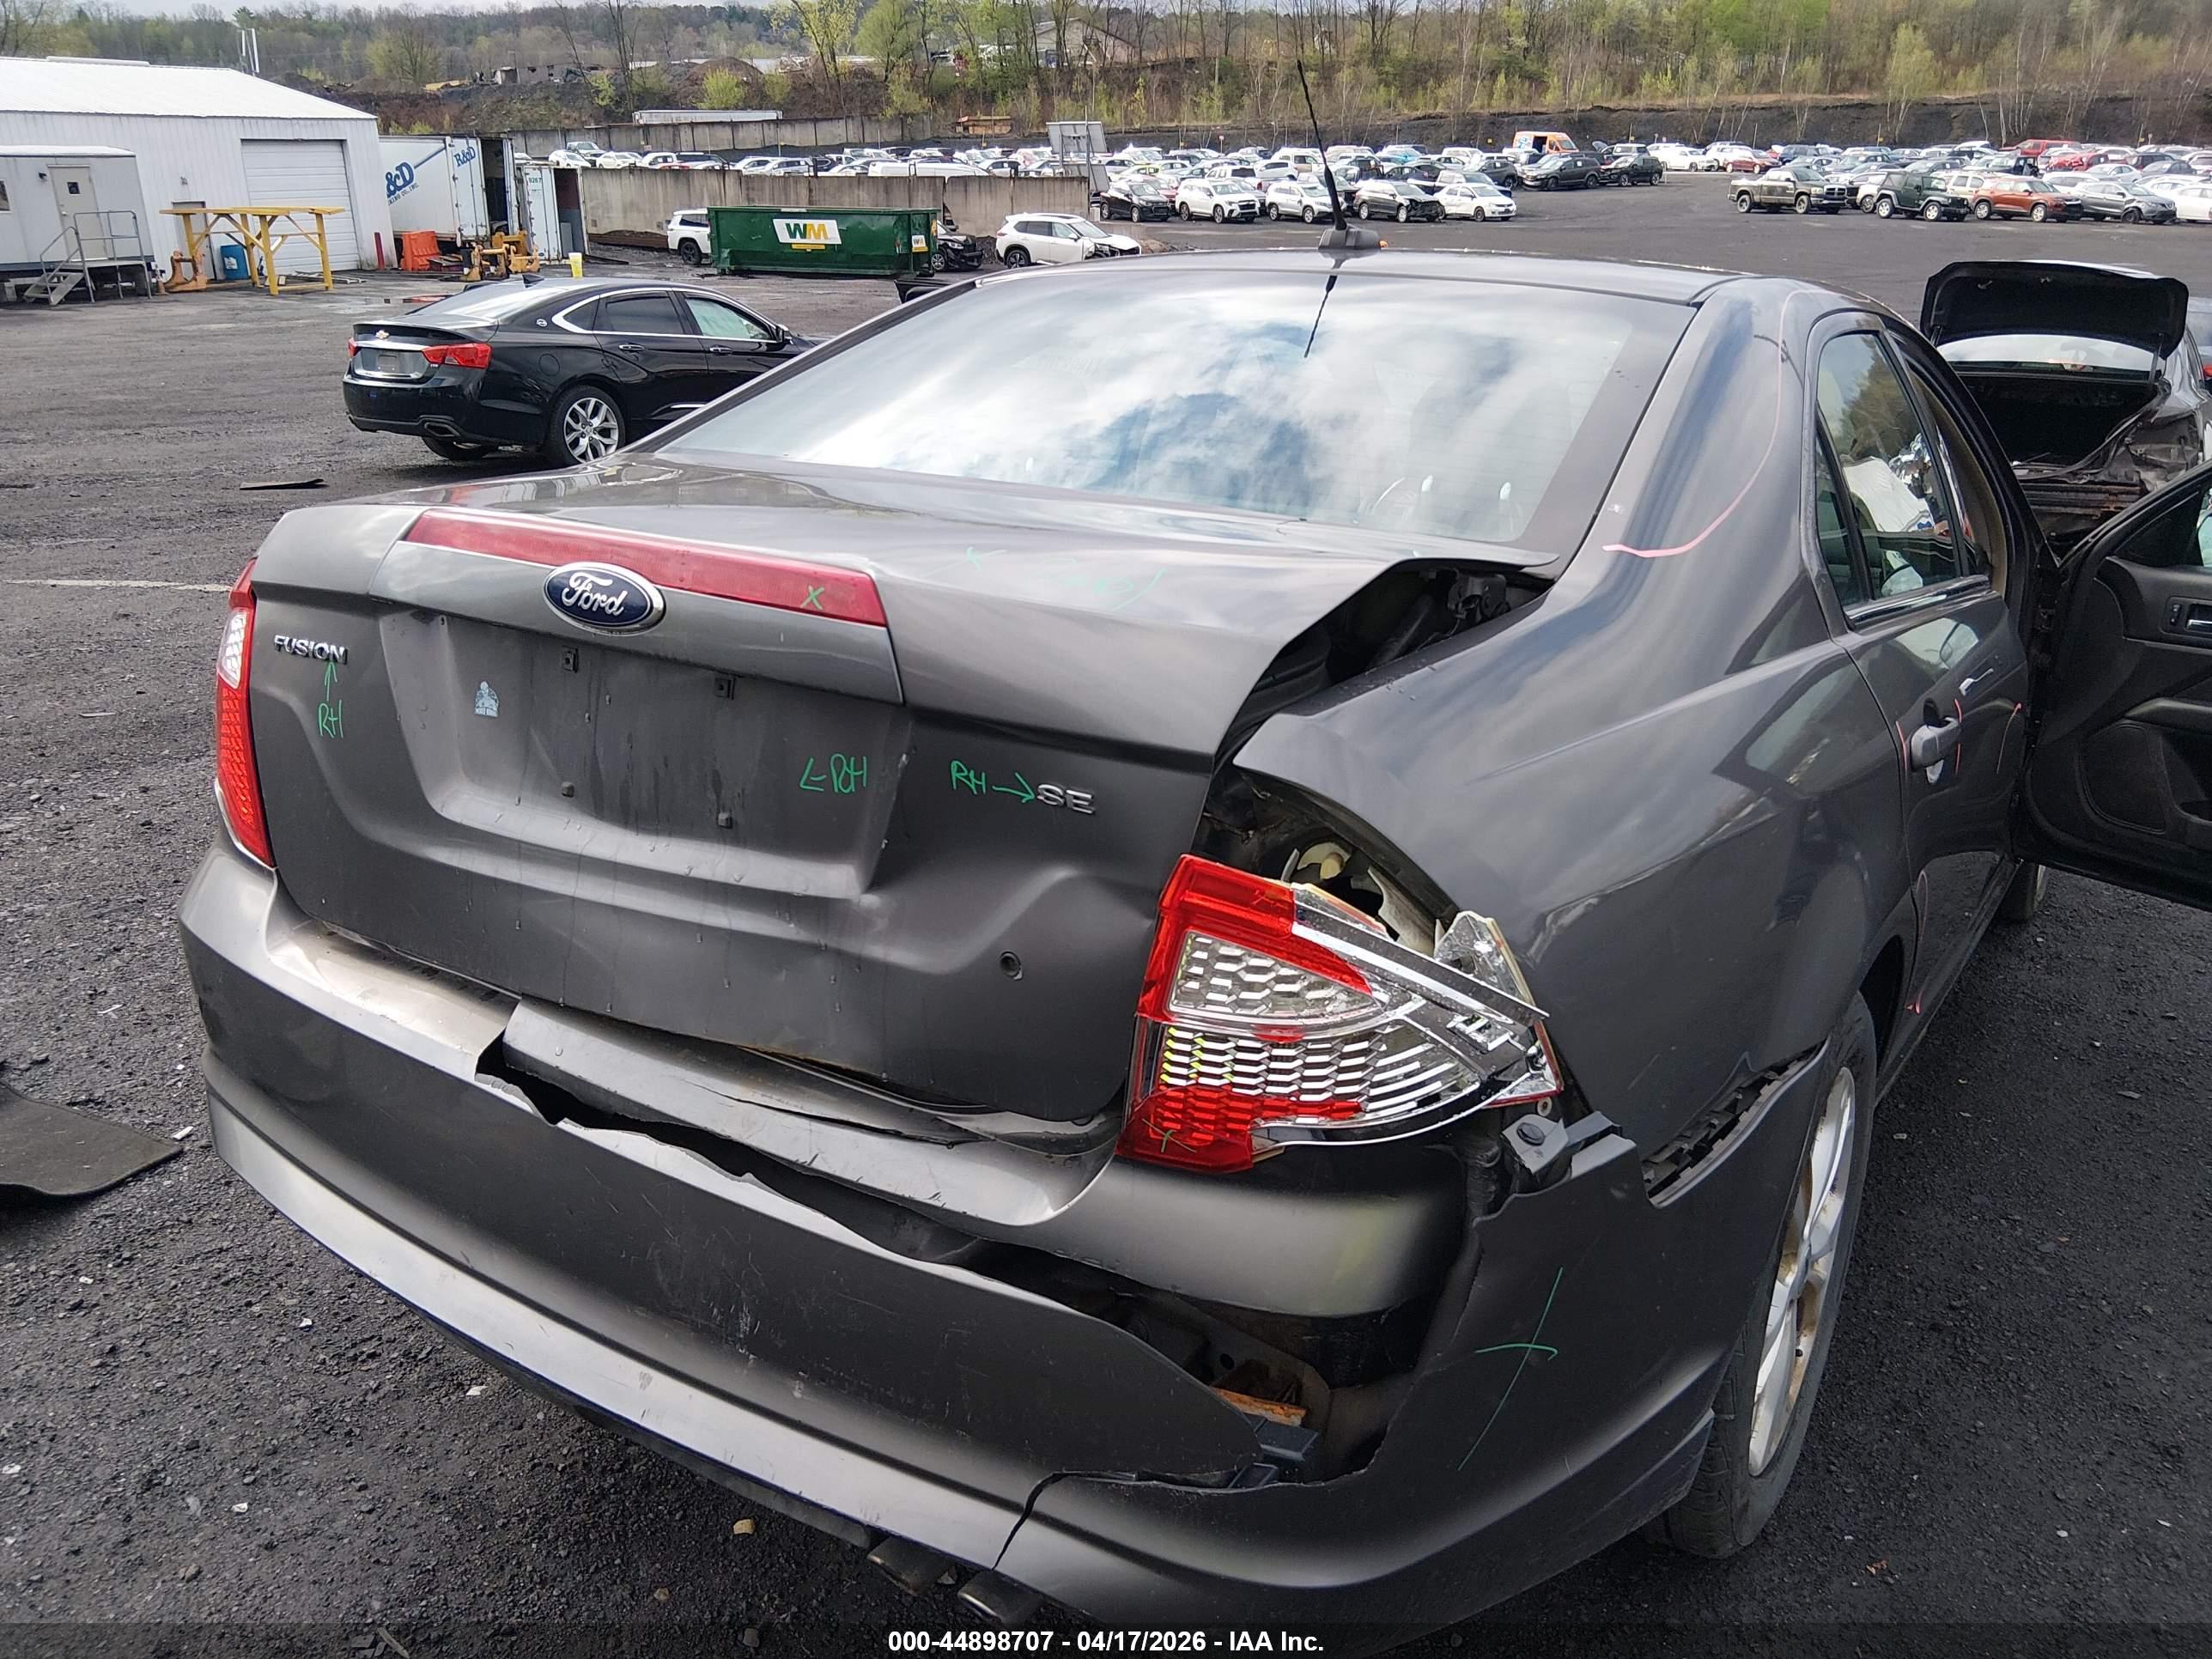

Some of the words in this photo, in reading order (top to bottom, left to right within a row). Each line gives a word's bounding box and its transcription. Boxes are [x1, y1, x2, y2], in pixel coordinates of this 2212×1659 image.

[453, 146, 477, 167] R&D
[386, 161, 414, 198] &D
[785, 222, 829, 240] WM
[562, 572, 629, 617] Ford
[273, 635, 349, 665] FUSION
[951, 760, 987, 794] RH
[1036, 783, 1096, 815] SE
